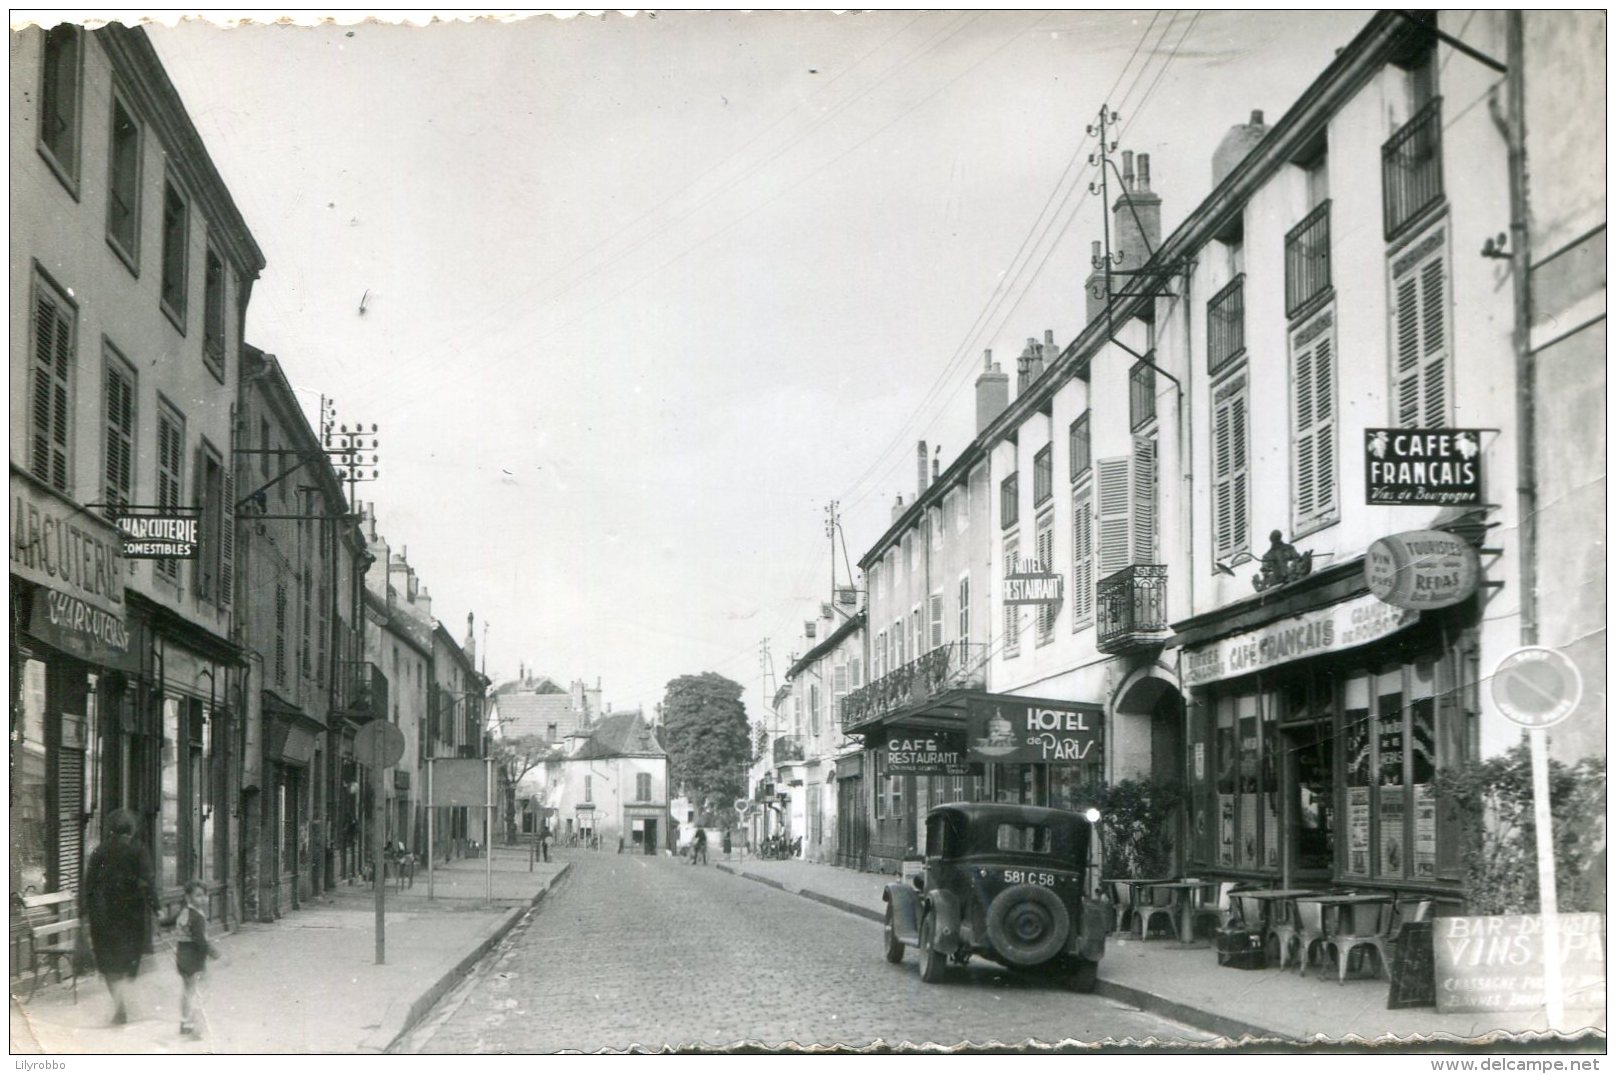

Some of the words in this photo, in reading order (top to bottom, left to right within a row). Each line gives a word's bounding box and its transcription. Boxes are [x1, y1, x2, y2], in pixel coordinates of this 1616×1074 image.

[1371, 462, 1476, 487] FRANÇAIS
[1372, 486, 1395, 500] Vins
[1397, 489, 1412, 500] de
[1415, 486, 1476, 504] Bourgogne
[10, 496, 122, 605] ARCUTERIE
[1371, 552, 1391, 565] VIN
[1416, 571, 1460, 592] REPAS
[1027, 707, 1090, 731] HOTEL
[1027, 736, 1042, 745] de
[888, 752, 959, 764] RESTAURANT
[1004, 870, 1025, 884] 581
[1028, 872, 1037, 885] C
[1038, 873, 1055, 886] 58
[1447, 935, 1533, 967] VINS
